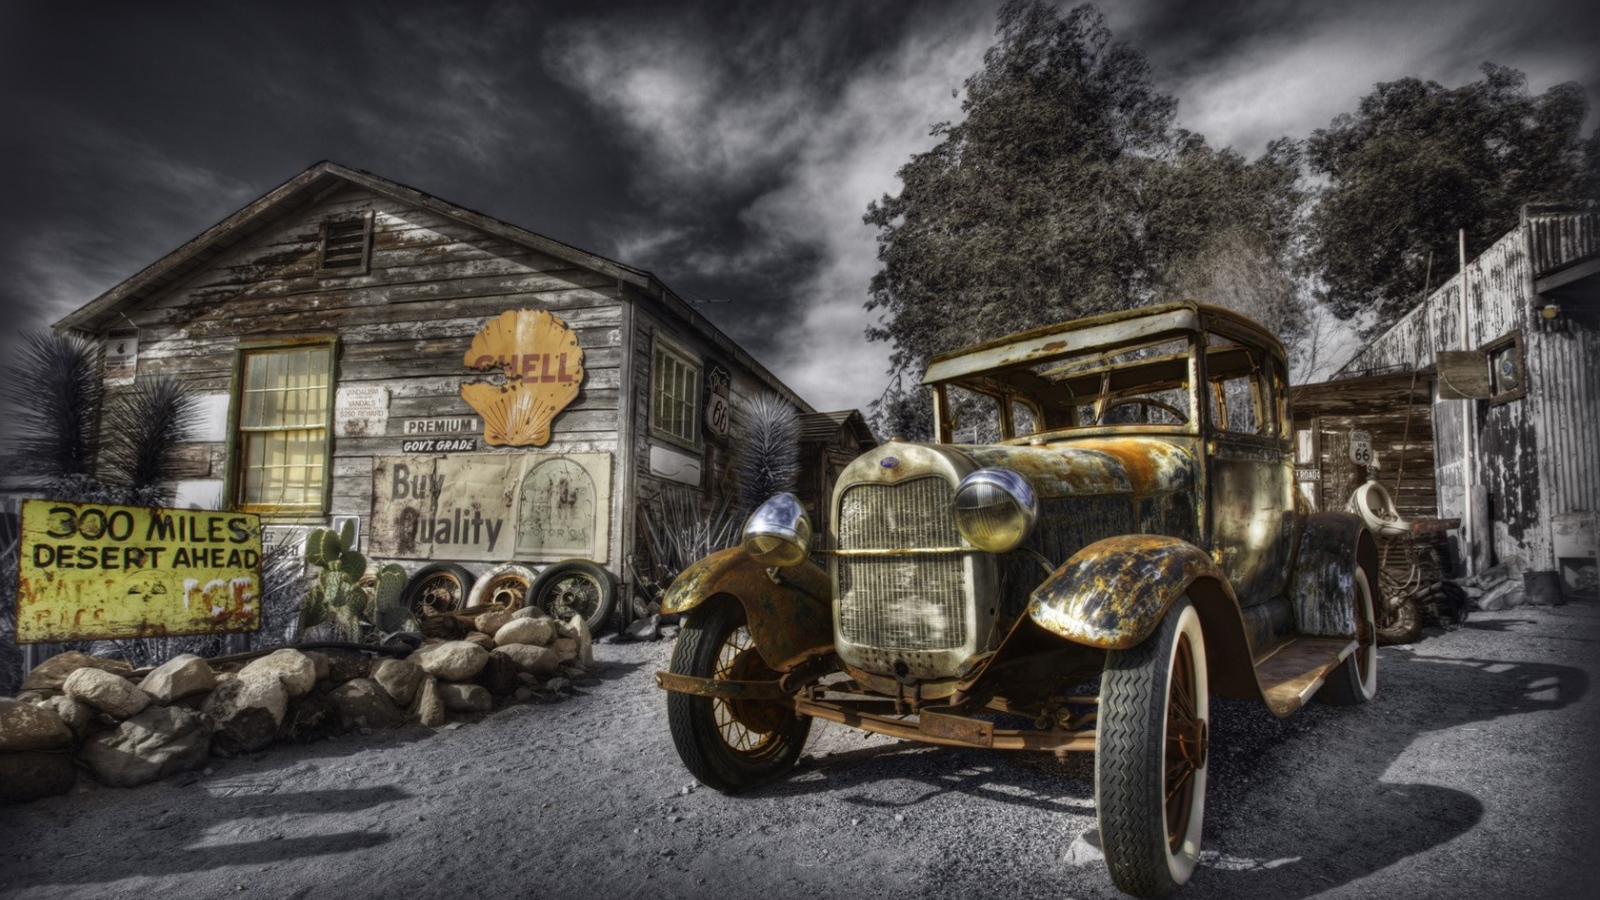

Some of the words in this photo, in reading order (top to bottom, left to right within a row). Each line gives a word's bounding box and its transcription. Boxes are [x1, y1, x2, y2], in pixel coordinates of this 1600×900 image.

[408, 419, 472, 433] PREMIUM
[713, 400, 727, 433] 66
[436, 440, 475, 451] GRADE
[1355, 448, 1370, 461] 66
[392, 463, 445, 511] Buy
[46, 507, 134, 541] 300
[146, 515, 250, 544] MILES
[398, 507, 503, 553] Quality
[32, 544, 166, 569] DESERT
[172, 547, 259, 569] AHEAD
